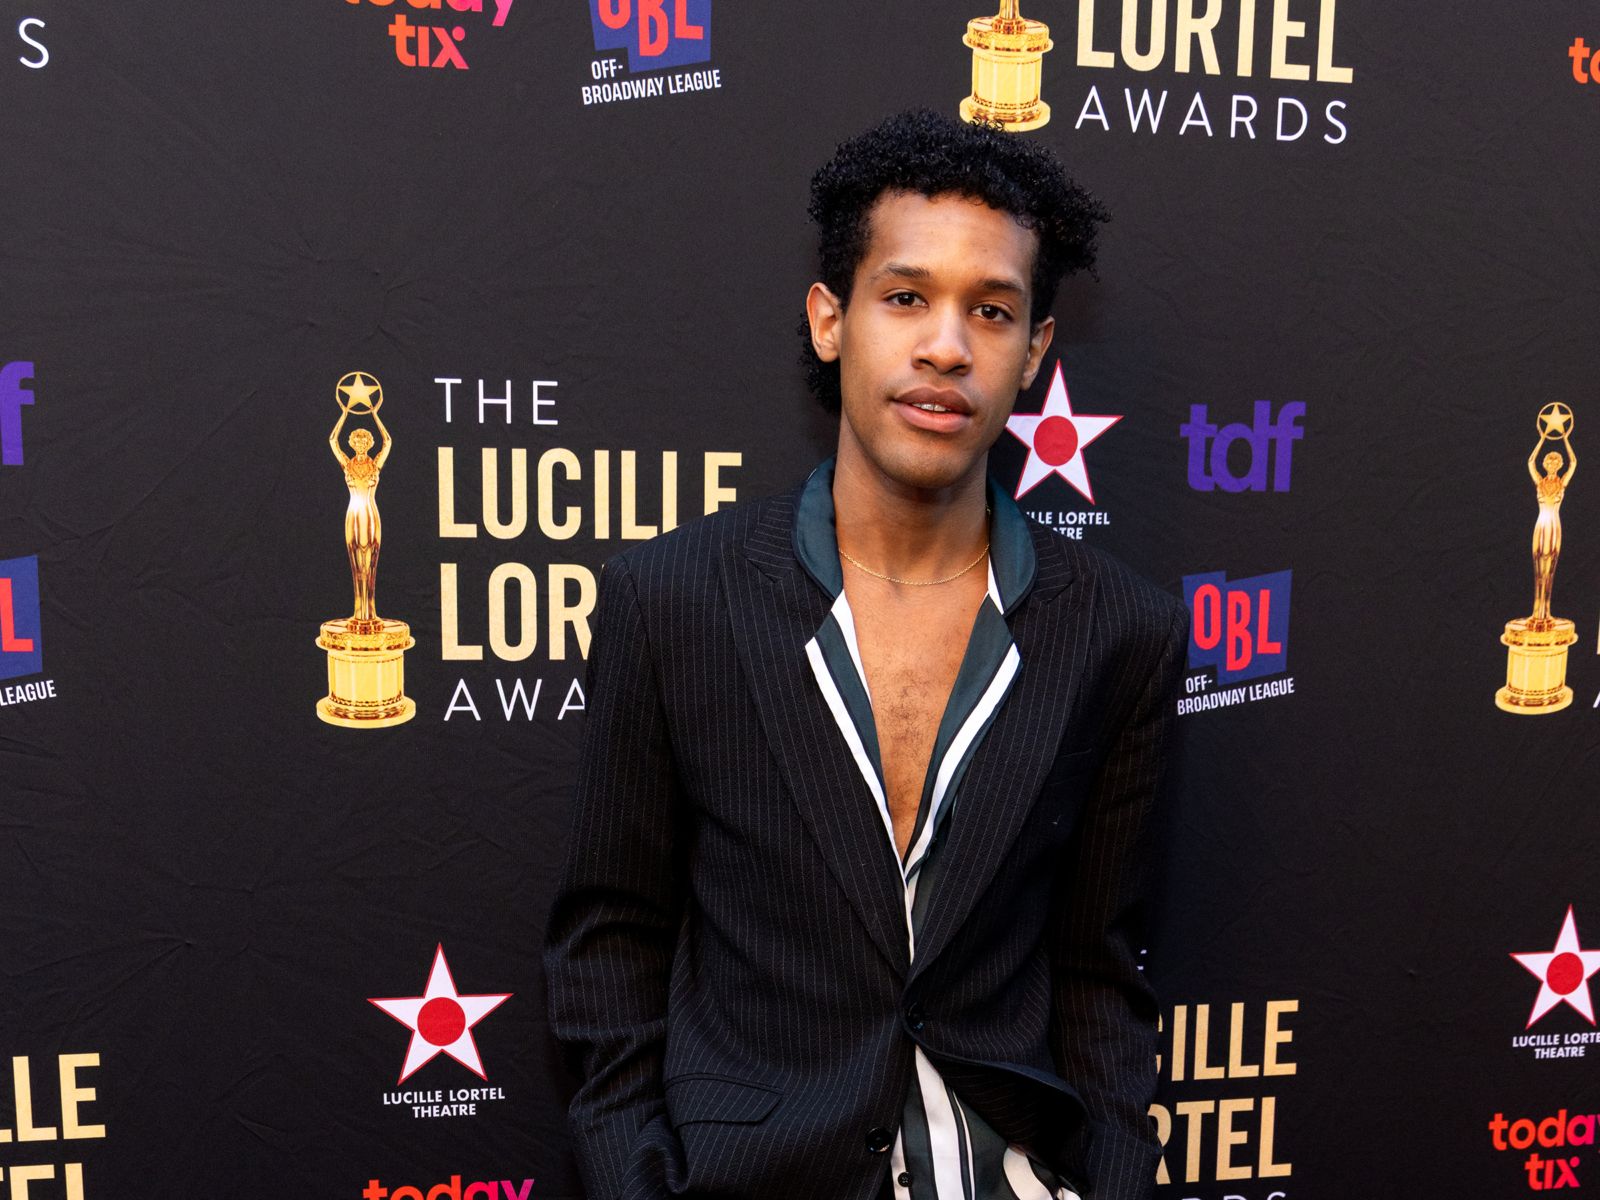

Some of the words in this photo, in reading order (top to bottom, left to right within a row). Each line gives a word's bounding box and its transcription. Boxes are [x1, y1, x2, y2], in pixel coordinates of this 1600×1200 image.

[388, 14, 470, 70] tix
[582, 76, 664, 105] BROADWAY
[667, 69, 722, 94] LEAGUE
[591, 59, 624, 80] OFF-
[1075, 85, 1347, 145] AWARDS
[434, 378, 559, 426] THE
[1180, 400, 1306, 493] tdf
[1058, 511, 1110, 525] LORTEL
[439, 562, 598, 661] LOR
[1193, 584, 1281, 671] OBL
[1177, 687, 1246, 716] BROADWAY
[1249, 678, 1295, 702] LEAGUE
[1185, 674, 1213, 694] OFF-
[1156, 1000, 1299, 1081] ILLE
[1512, 1033, 1560, 1048] LUCILLE
[1534, 1046, 1586, 1060] THEATRE
[383, 1090, 443, 1105] LUCILLE
[449, 1087, 506, 1102] LORTEL
[412, 1103, 477, 1118] THEATRE
[1488, 1108, 1600, 1152] toda
[1524, 1153, 1581, 1191] tix
